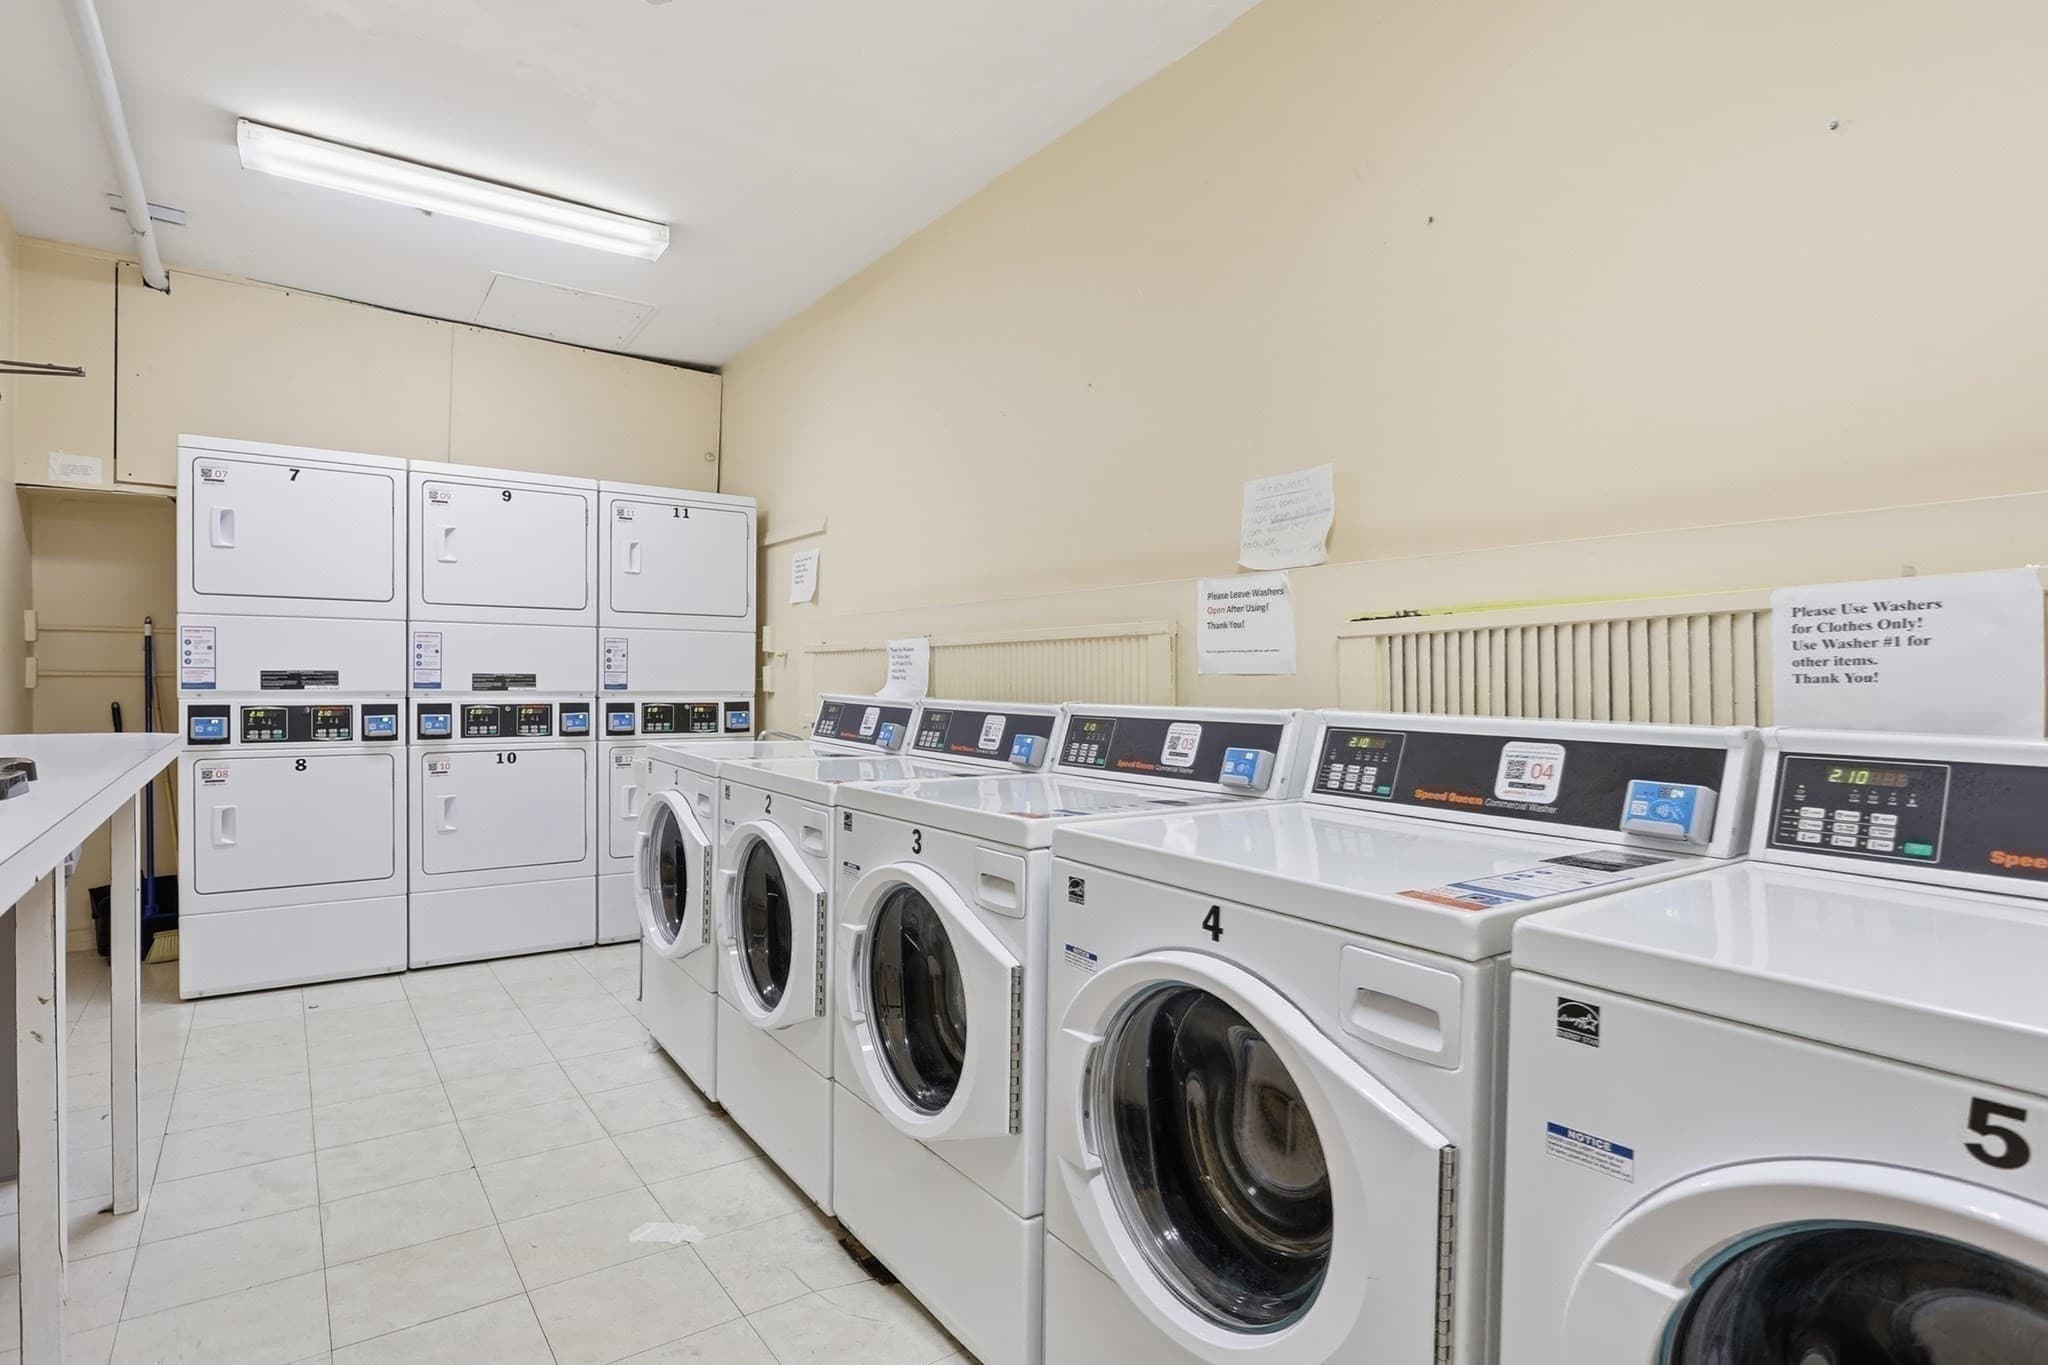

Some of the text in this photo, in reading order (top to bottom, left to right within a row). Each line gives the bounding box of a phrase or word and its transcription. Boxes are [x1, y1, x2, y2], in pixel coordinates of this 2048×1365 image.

[215, 469, 229, 478] 07
[289, 468, 300, 481] 7
[502, 490, 512, 502] 9
[672, 507, 689, 519] 11
[1207, 587, 1285, 601] Please Leave Washers
[1207, 602, 1269, 615] Open After Using!
[1792, 599, 1943, 618] Please Use Washers
[1207, 620, 1245, 630] Thank You!
[1792, 616, 1923, 634] for Clothes Only!
[1792, 634, 1933, 651] Use Washer #1 for
[1792, 655, 1879, 668] other items.
[1792, 671, 1880, 684] Thank You!
[1181, 737, 1194, 751] 03
[295, 758, 307, 772] 8
[495, 752, 517, 765] 10
[440, 762, 451, 770] 10
[1529, 763, 1554, 780] 04
[215, 770, 229, 779] 08
[674, 769, 679, 785] 1
[765, 794, 772, 814] 2
[1414, 788, 1559, 814] Speed Queen Commercial Washer
[912, 829, 922, 855] 3
[1202, 905, 1223, 942] 4
[1964, 1097, 2031, 1170] 5
[1567, 1129, 1611, 1153] NOTICE
